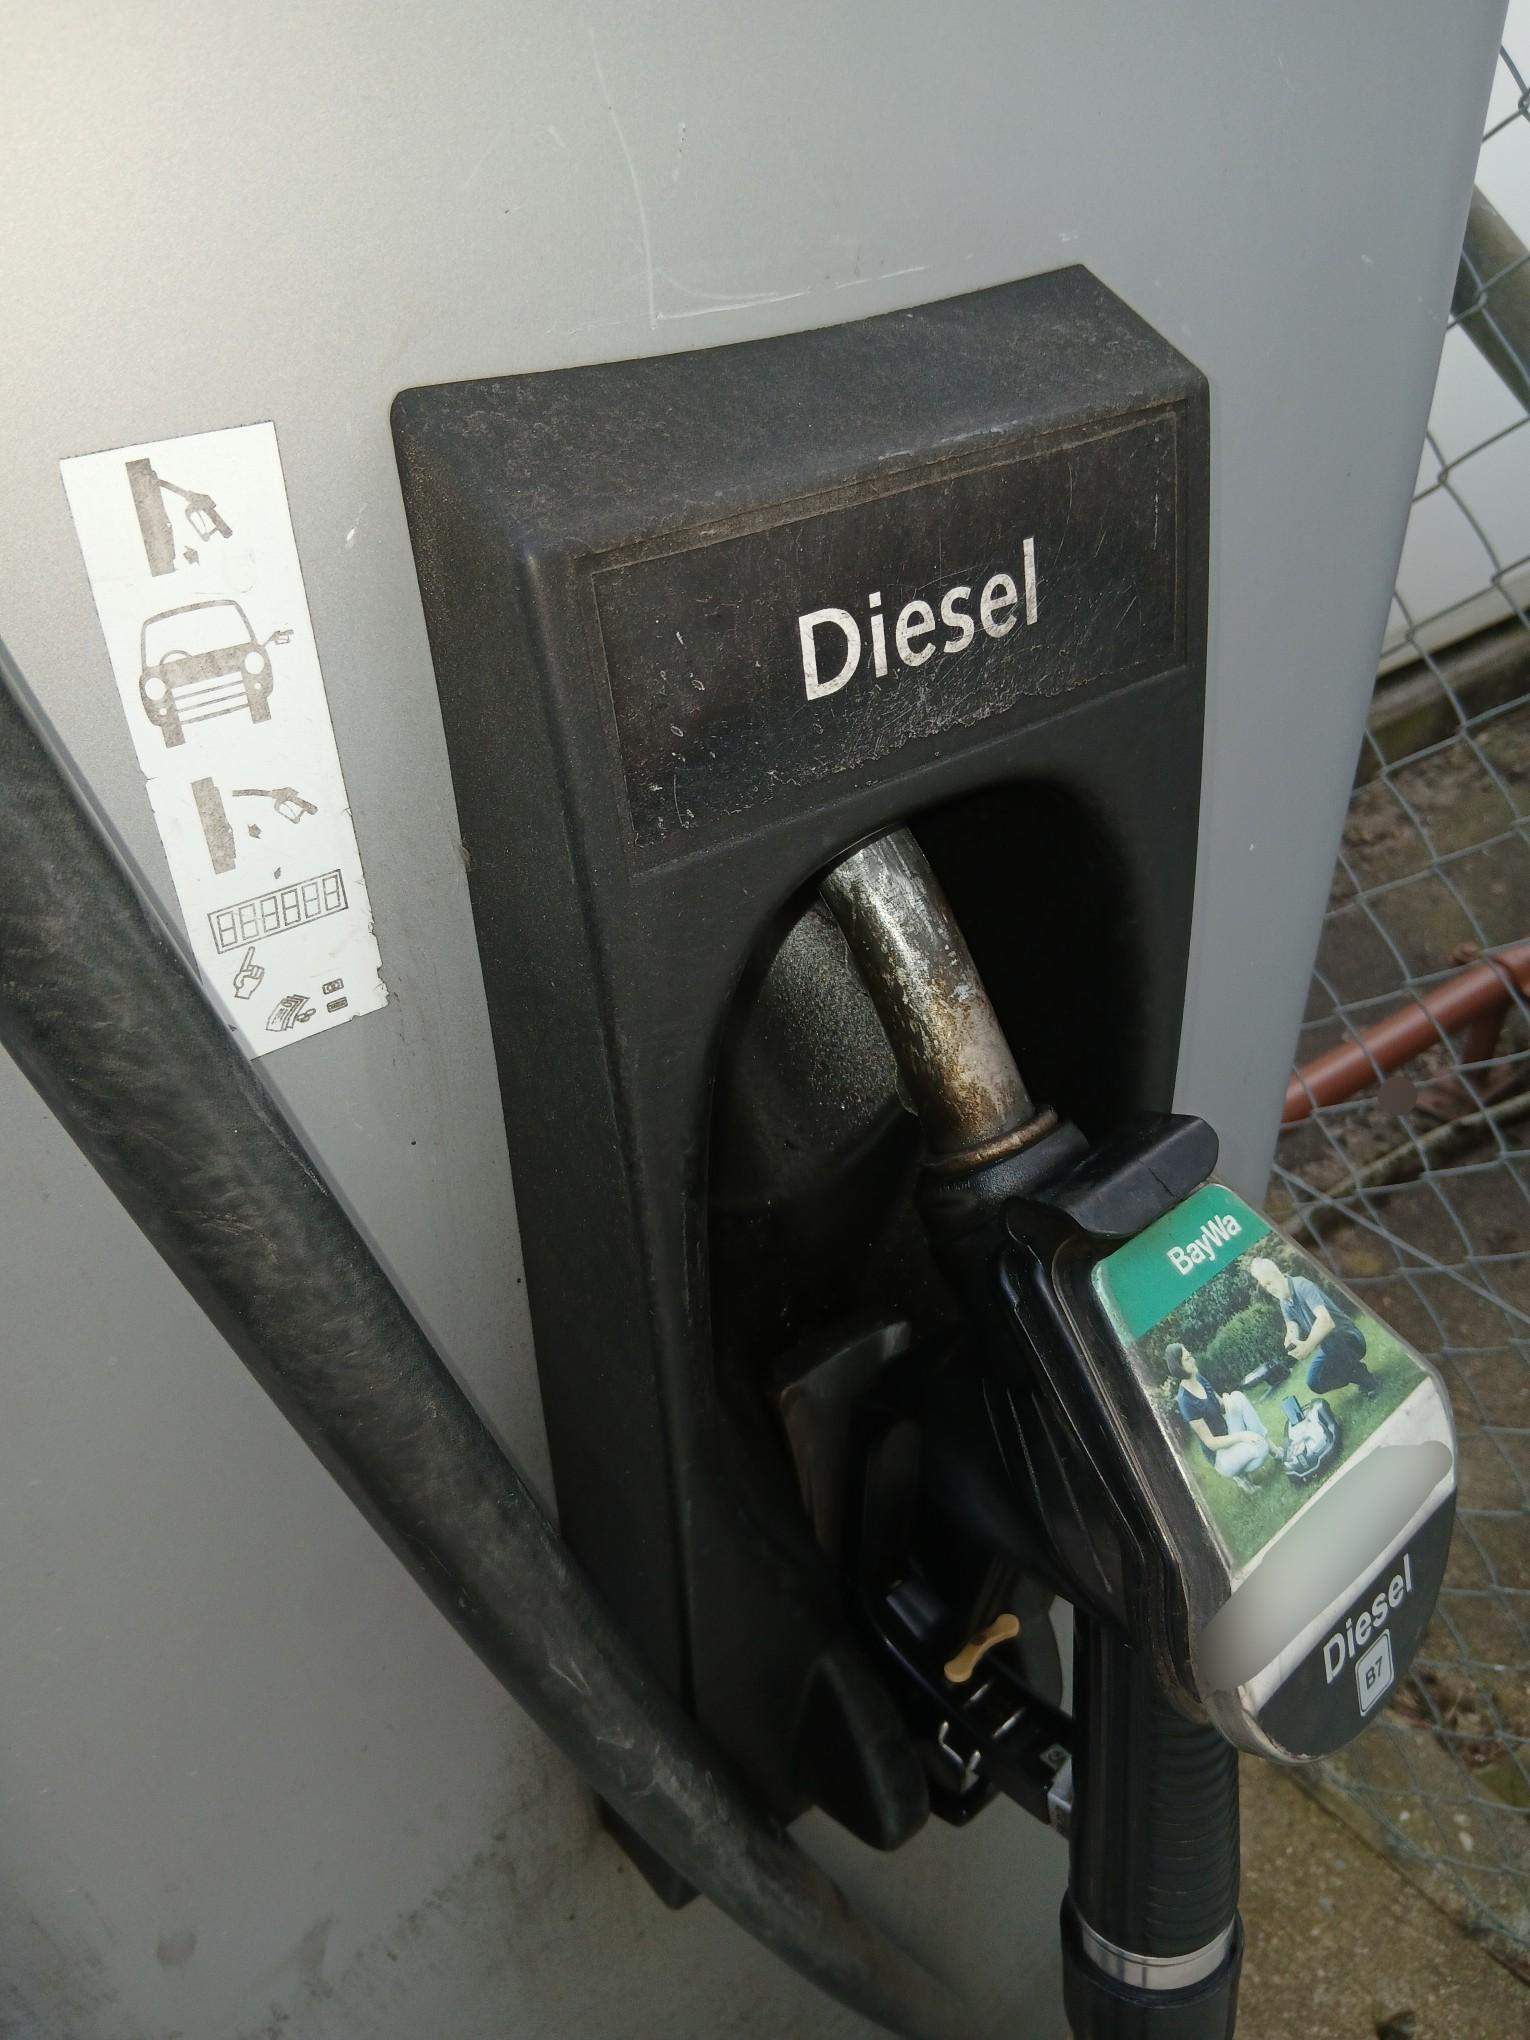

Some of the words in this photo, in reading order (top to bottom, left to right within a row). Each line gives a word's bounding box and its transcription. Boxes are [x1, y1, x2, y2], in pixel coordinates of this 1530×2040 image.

[799, 537, 1038, 701] Diesel
[1166, 1214, 1243, 1276] BayWa
[1323, 1553, 1413, 1684] Diesel
[1365, 1656, 1383, 1690] B7
